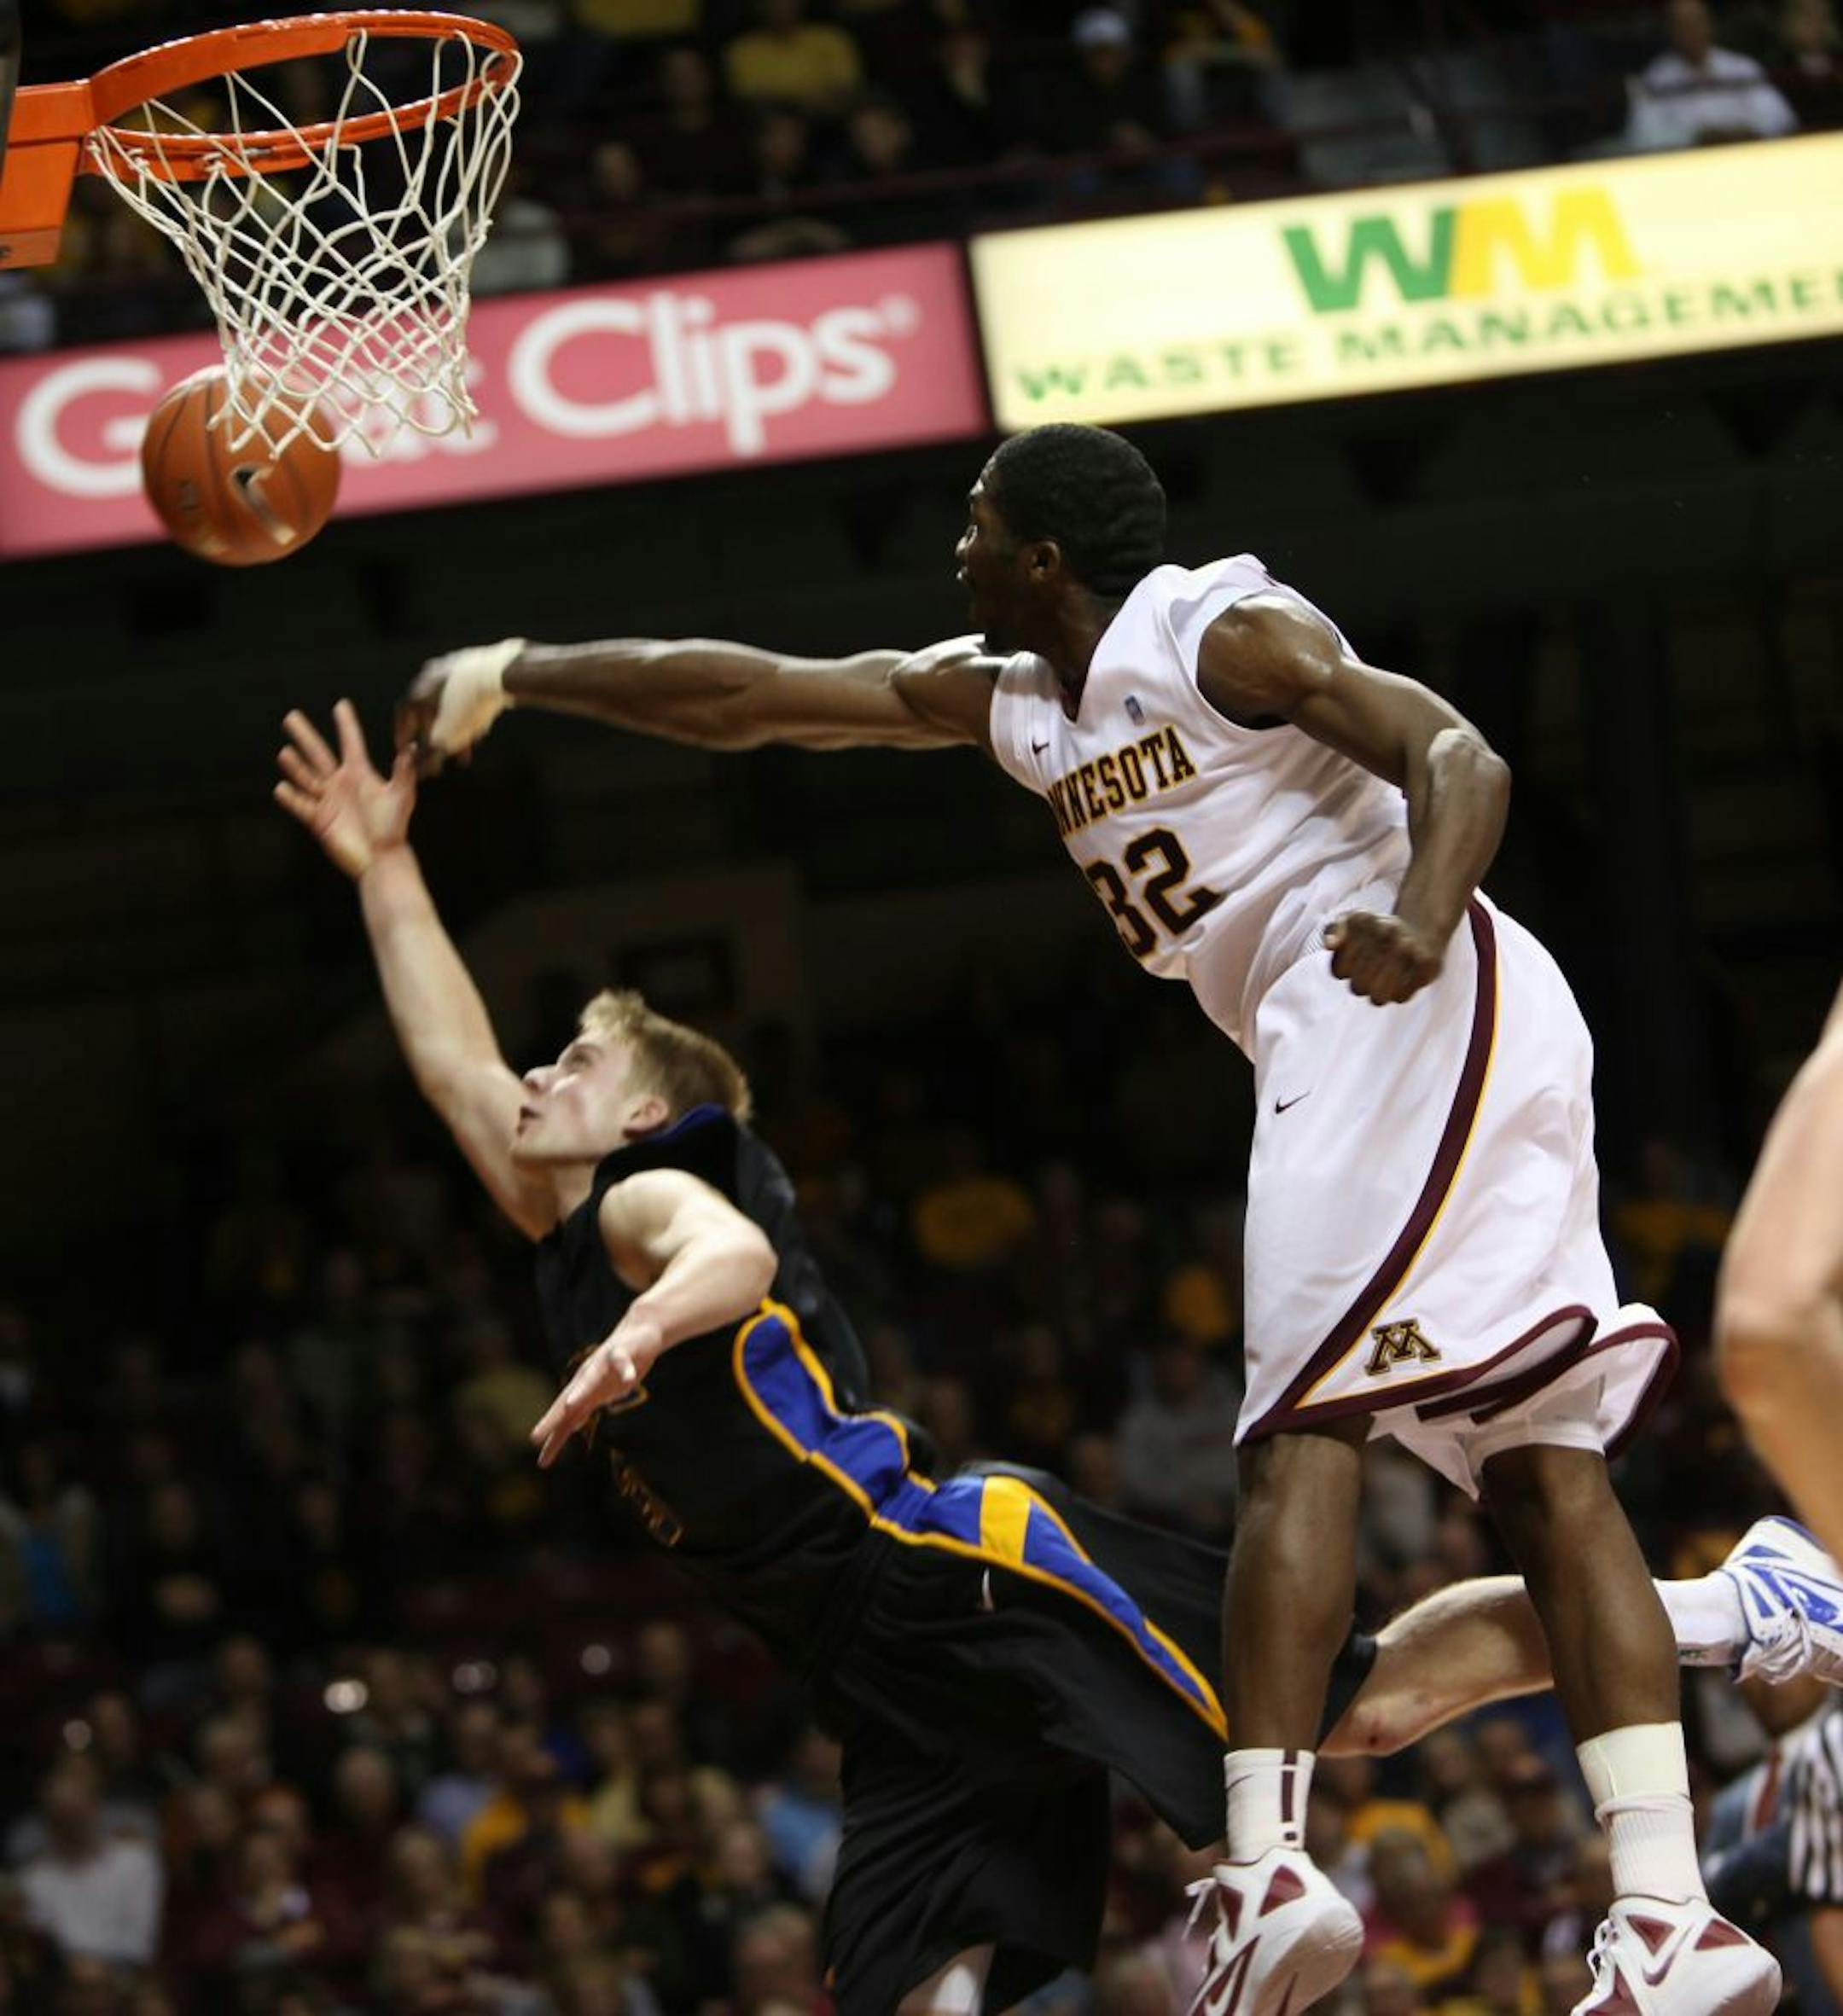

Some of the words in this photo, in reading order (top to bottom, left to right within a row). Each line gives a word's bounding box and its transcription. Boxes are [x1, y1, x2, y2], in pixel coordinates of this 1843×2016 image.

[1283, 185, 1642, 314] WM
[1017, 336, 1297, 403] WASTE
[1336, 266, 1843, 362] MANAGEME
[17, 348, 502, 498] Gat
[1045, 723, 1199, 840] NNESOTA
[1084, 827, 1224, 959] 32
